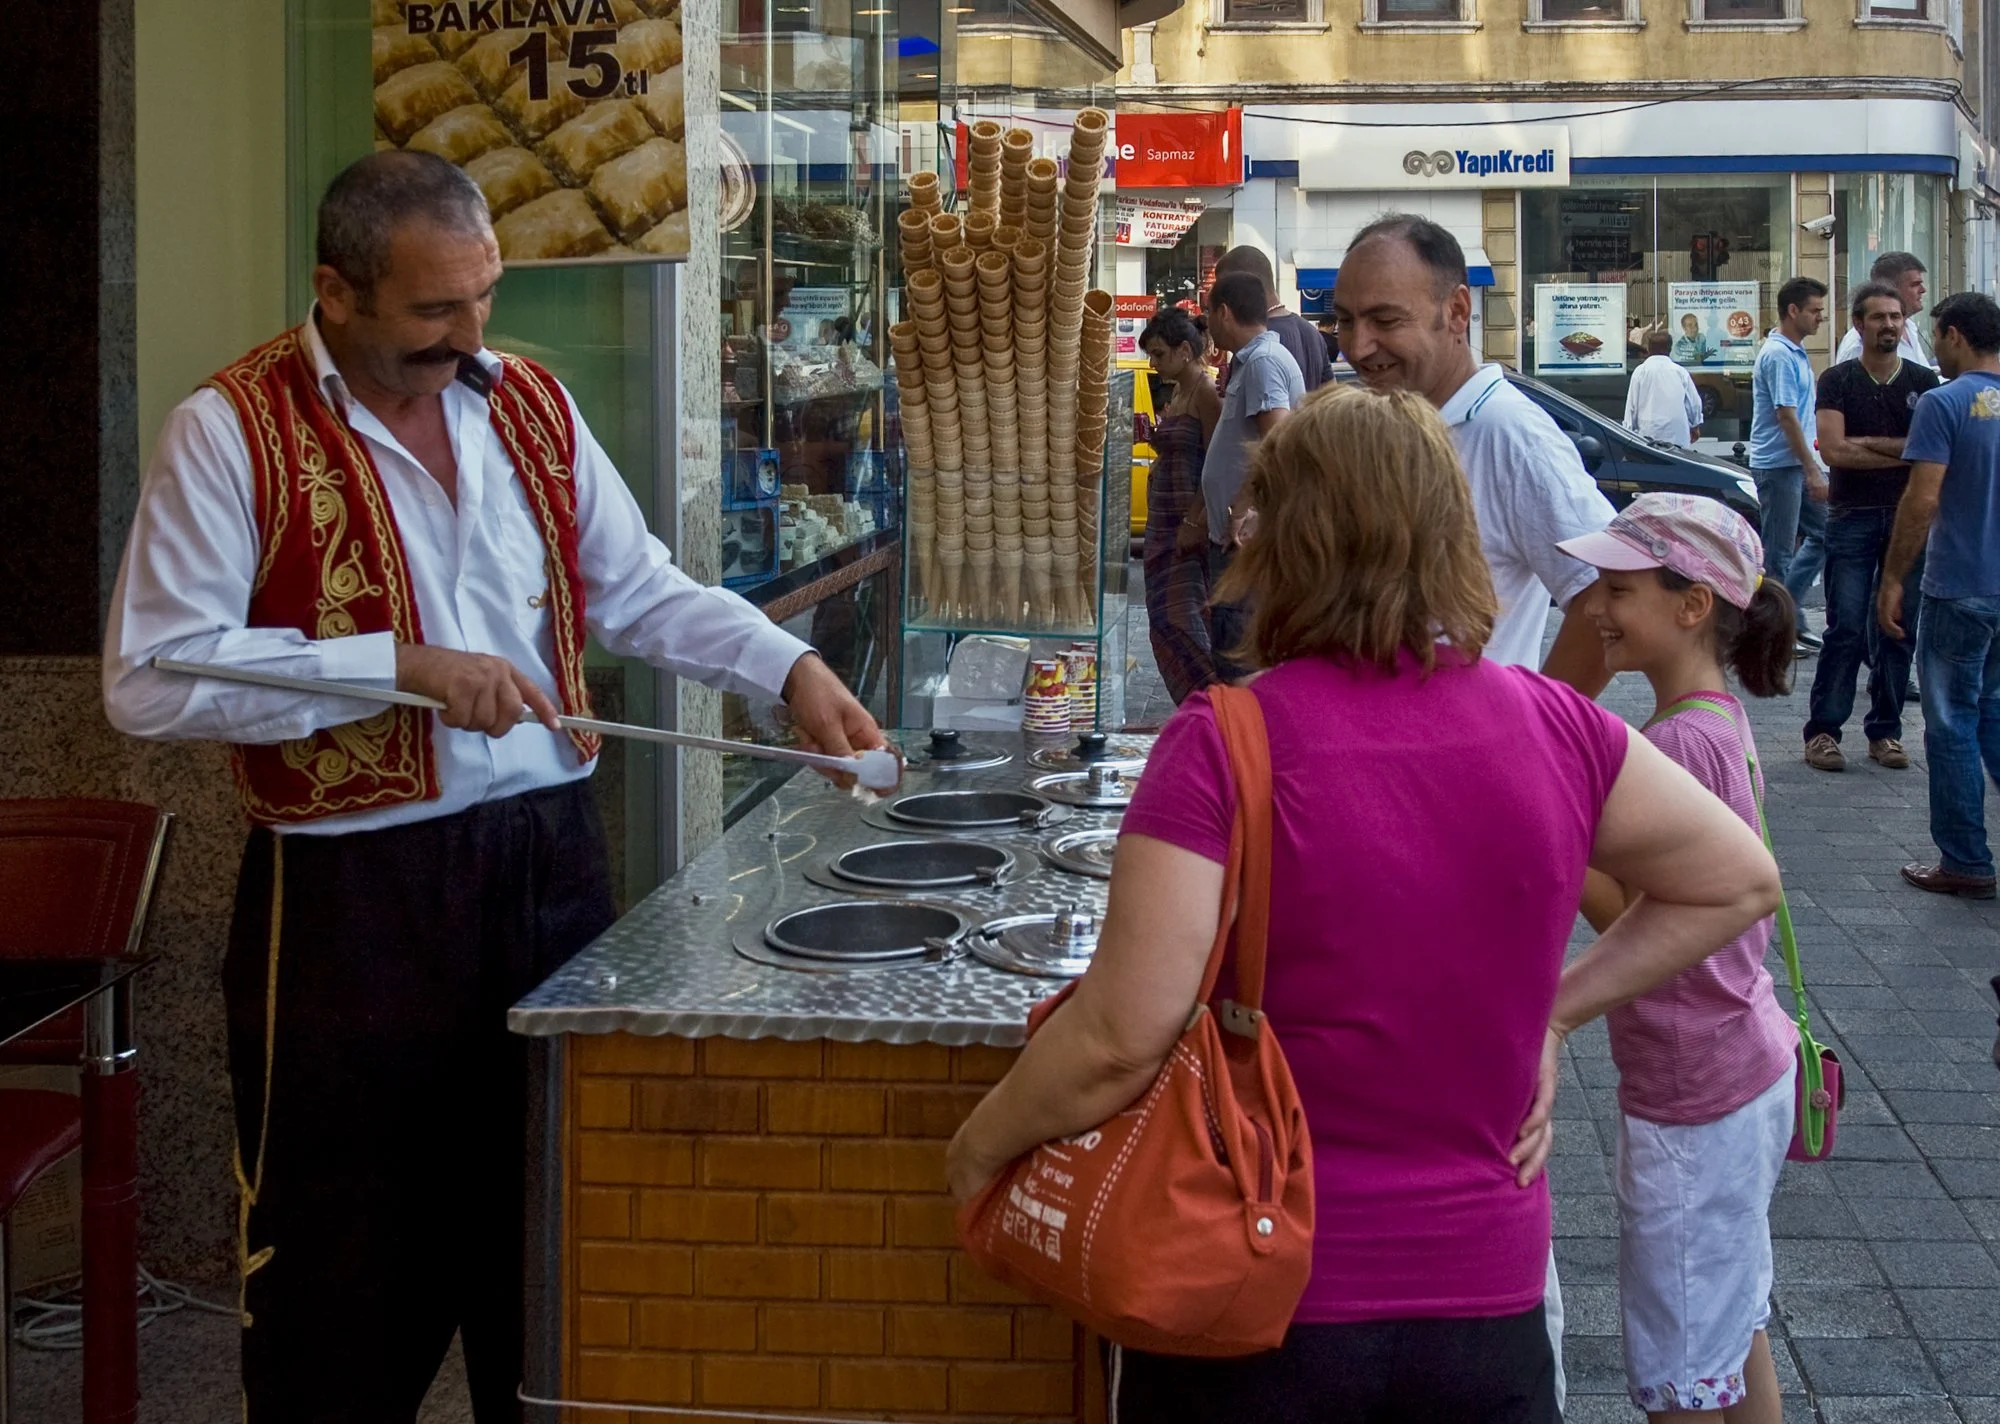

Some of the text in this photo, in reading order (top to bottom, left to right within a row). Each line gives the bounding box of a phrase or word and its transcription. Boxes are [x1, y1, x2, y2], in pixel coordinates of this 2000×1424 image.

[407, 0, 617, 34] BAKLAVA
[1147, 148, 1195, 163] Sapmaz
[1145, 221, 1190, 232] FATURASI
[1116, 302, 1154, 312] odafone
